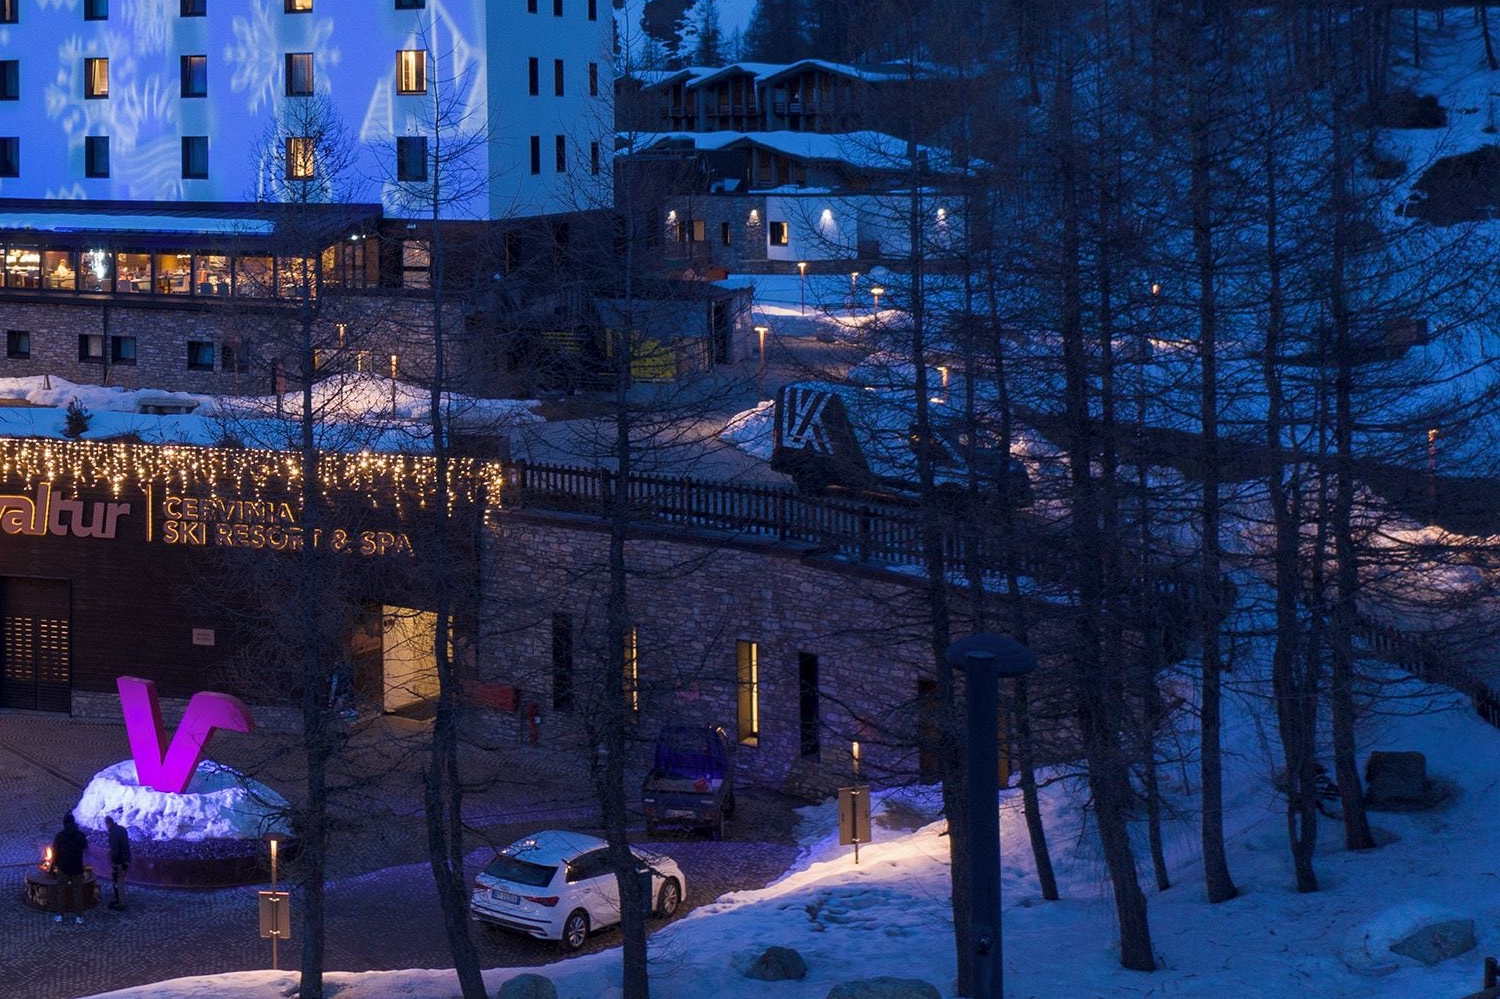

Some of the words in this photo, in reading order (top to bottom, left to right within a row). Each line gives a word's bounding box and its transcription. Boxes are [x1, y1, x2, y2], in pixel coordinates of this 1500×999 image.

[163, 520, 206, 545] SKI
[332, 529, 353, 553] &
[360, 531, 415, 557] SPA
